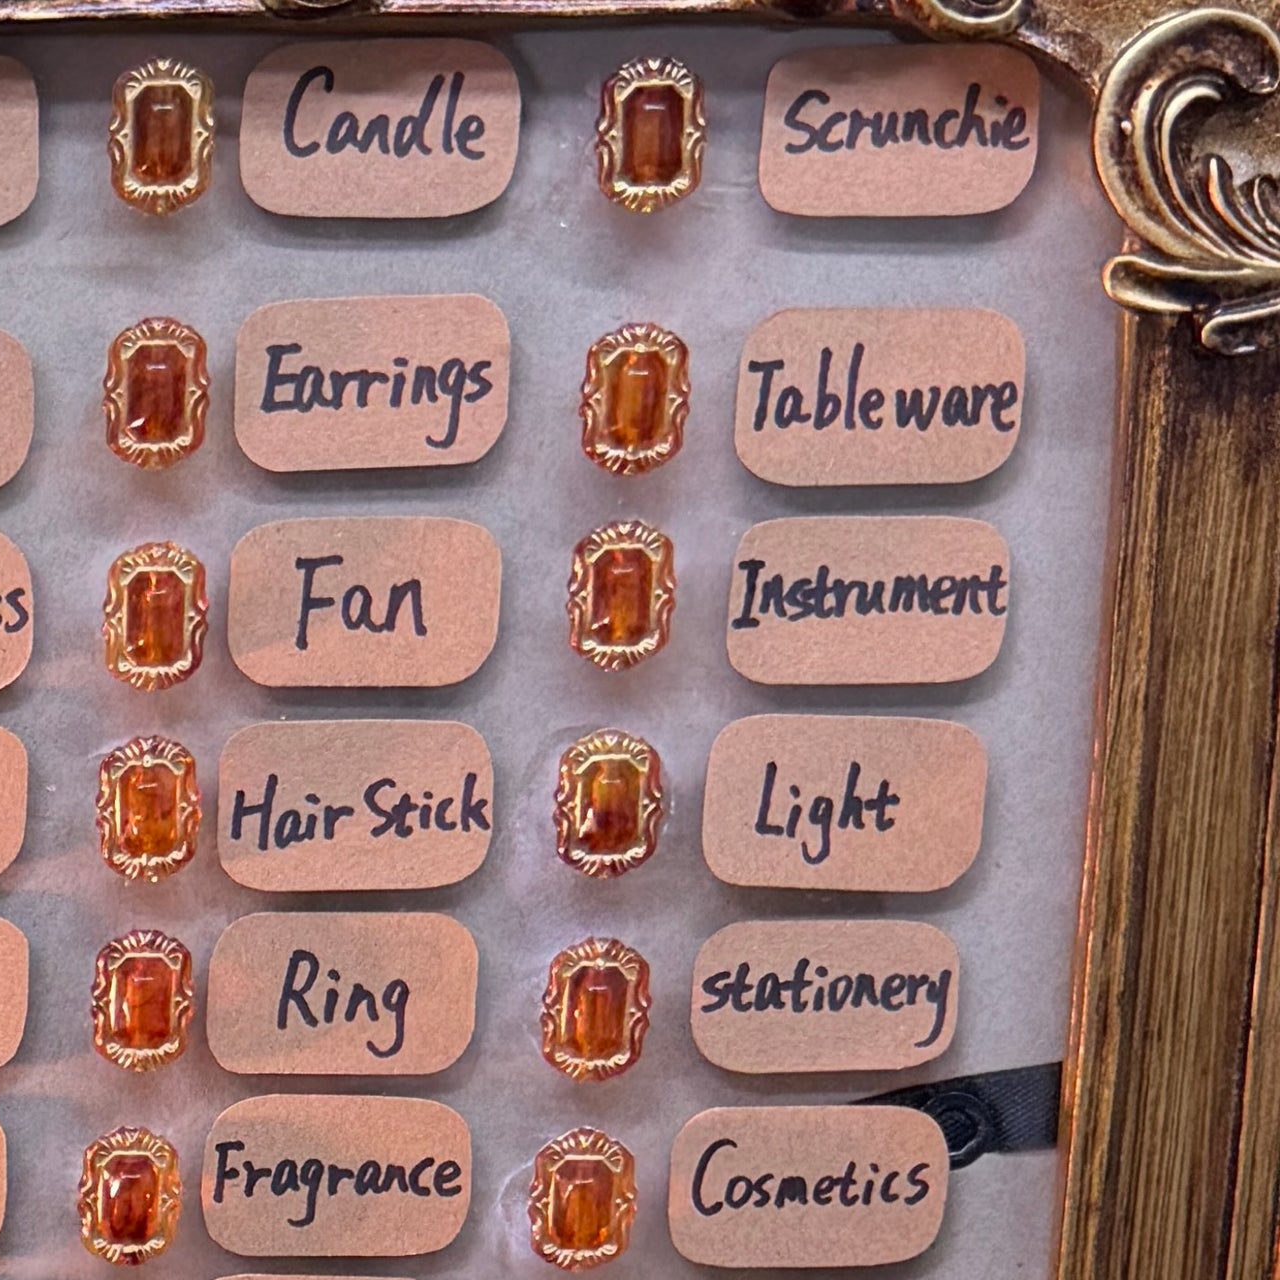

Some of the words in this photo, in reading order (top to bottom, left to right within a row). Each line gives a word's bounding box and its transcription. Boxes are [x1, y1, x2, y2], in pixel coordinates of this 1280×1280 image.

[283, 68, 486, 159] Candle
[785, 76, 1029, 153] Scrunchie
[261, 344, 493, 451] Earrings
[748, 343, 1020, 432] Tableware
[296, 555, 427, 650] Fan
[732, 559, 1007, 628] Instrument
[755, 763, 900, 864] Light
[278, 950, 409, 1057] Ring
[214, 1141, 461, 1227] Fragrance
[693, 1139, 929, 1216] Cosmetics
